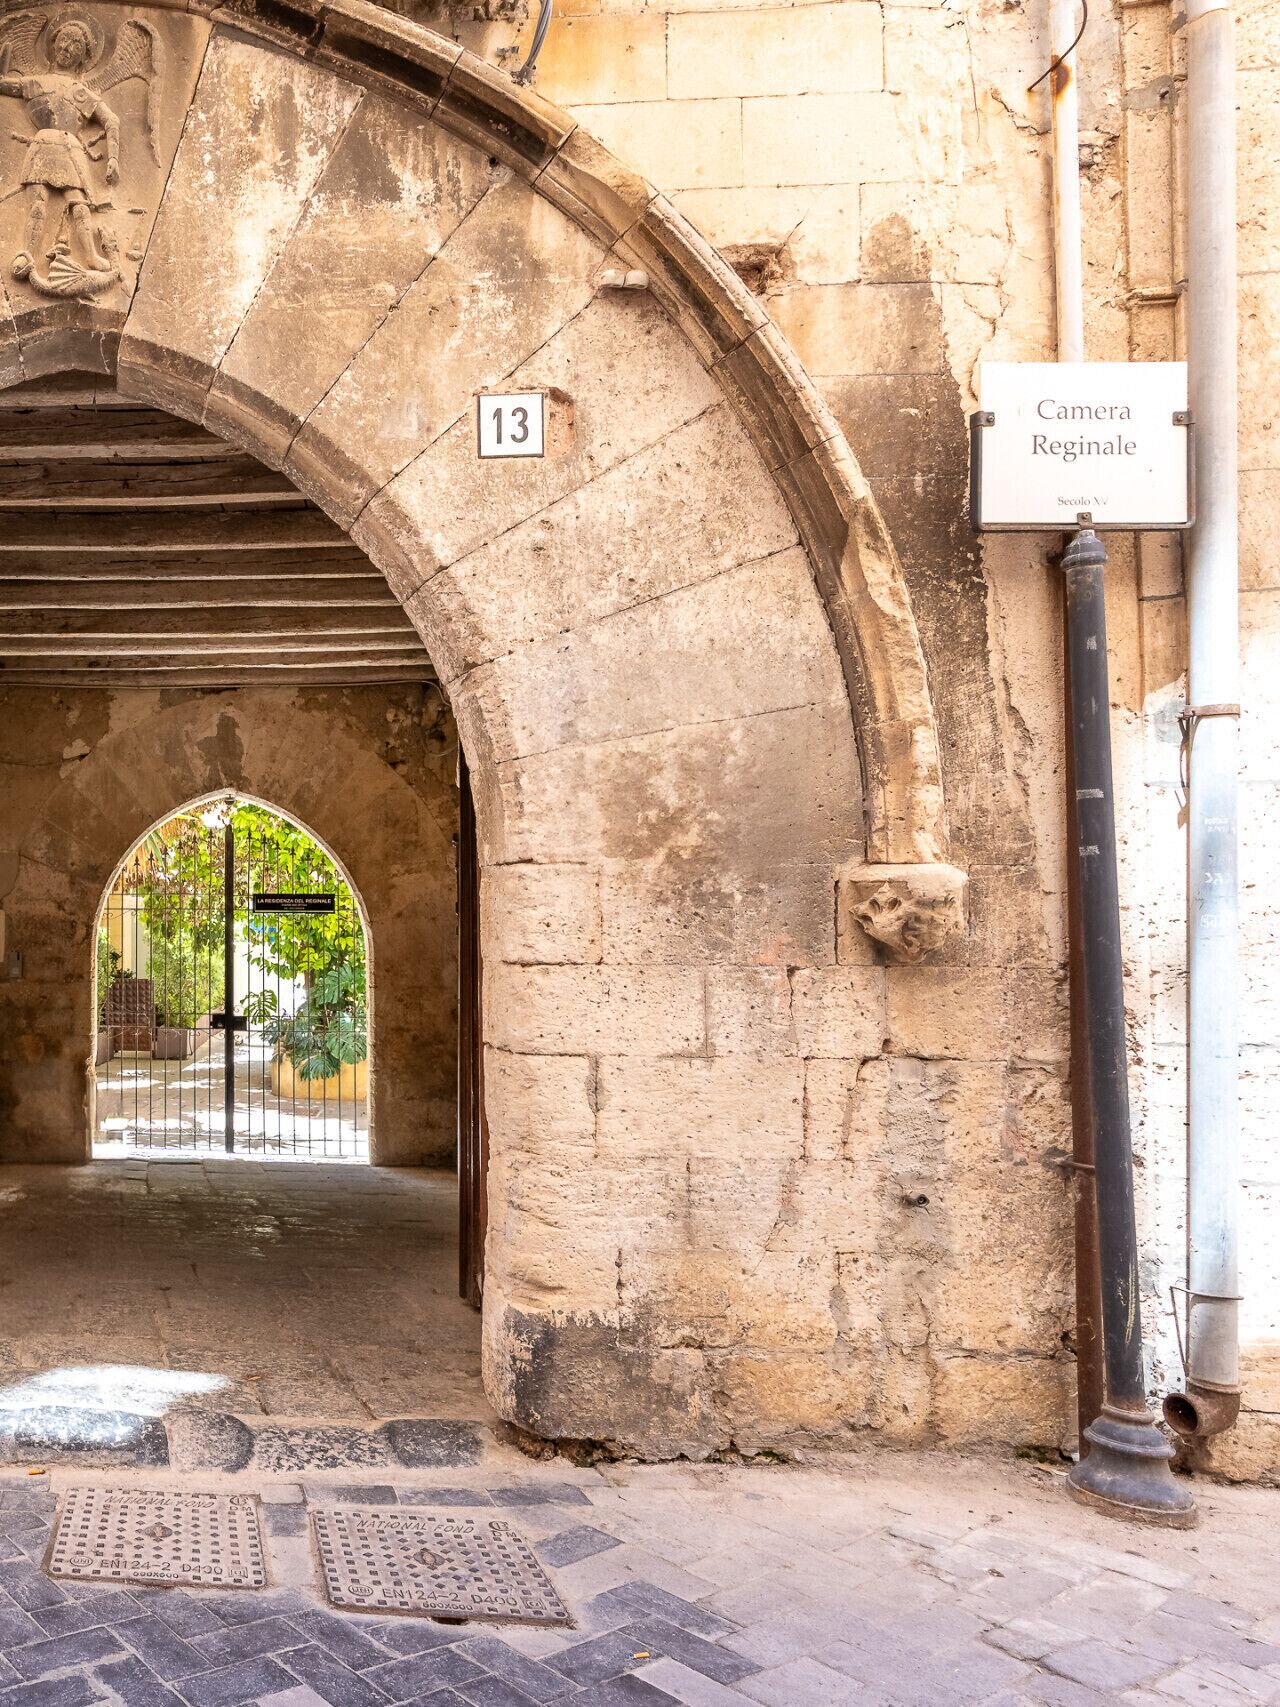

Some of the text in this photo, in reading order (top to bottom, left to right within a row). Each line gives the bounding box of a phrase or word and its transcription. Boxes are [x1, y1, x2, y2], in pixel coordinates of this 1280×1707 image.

[1037, 398, 1132, 421] Camera
[492, 406, 529, 445] 13
[1031, 434, 1138, 463] Reginale
[1057, 496, 1091, 507] Secolo
[104, 1495, 171, 1507] NATIONAL
[175, 1498, 215, 1509] FOND
[356, 1519, 428, 1532] NATIONAL
[433, 1523, 475, 1535] FOND
[100, 1559, 172, 1572] EN124-2
[181, 1563, 223, 1575] D400
[382, 1588, 462, 1603] EN124-2
[470, 1594, 519, 1607] D400
